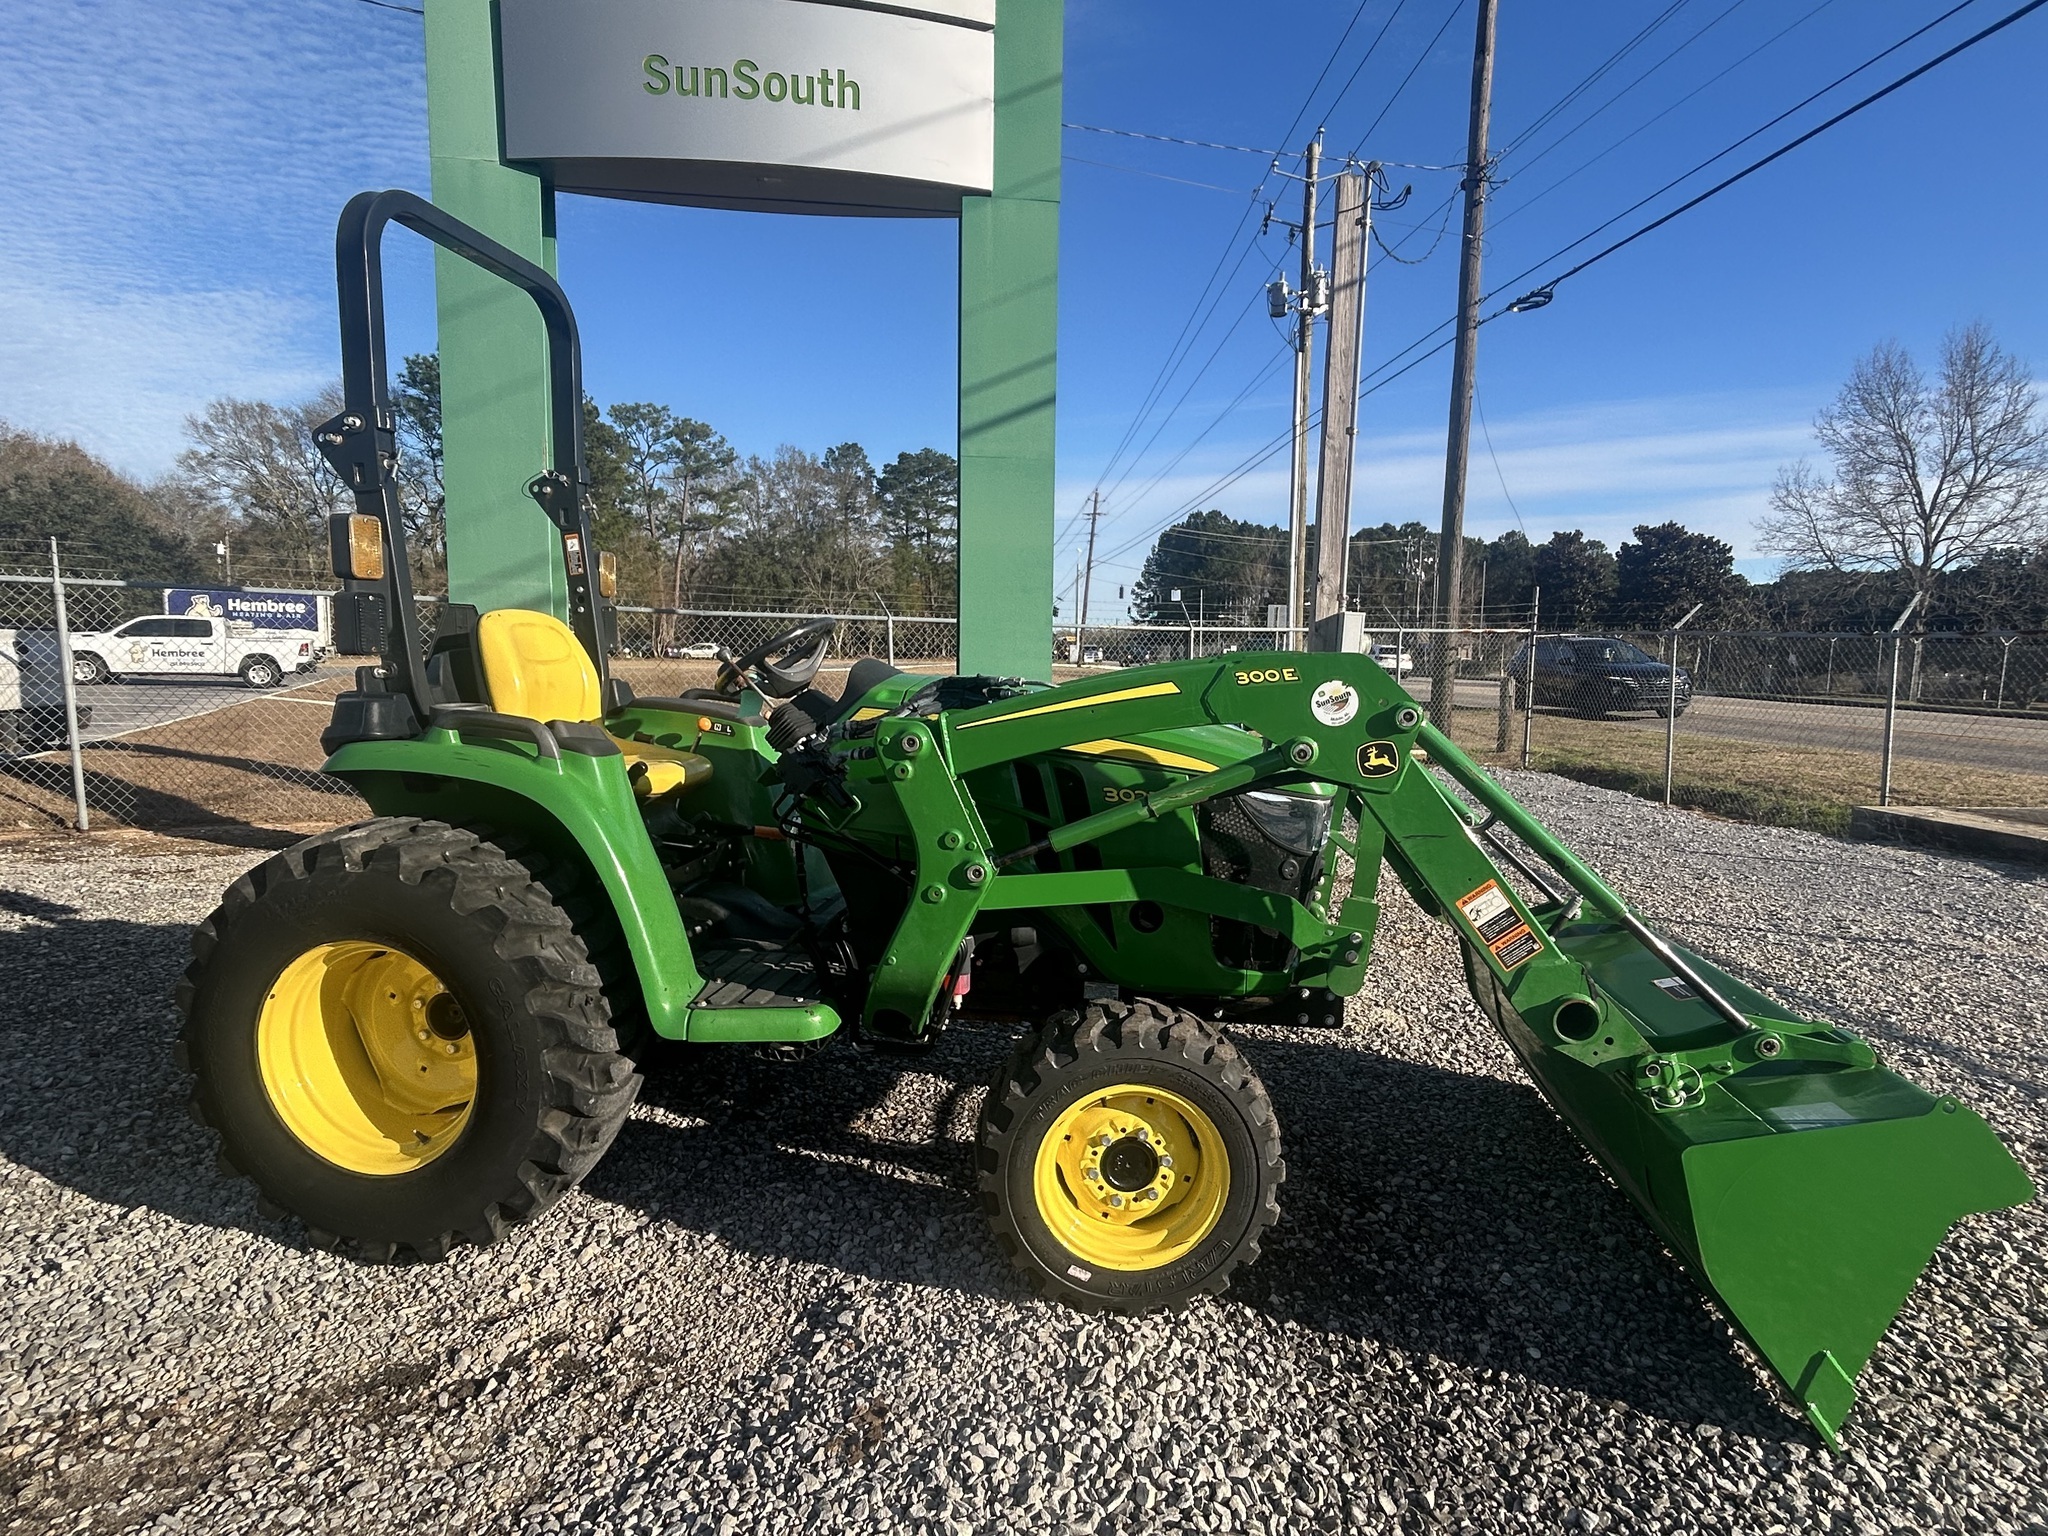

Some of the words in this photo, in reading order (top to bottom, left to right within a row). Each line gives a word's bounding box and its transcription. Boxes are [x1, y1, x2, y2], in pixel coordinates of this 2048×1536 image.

[641, 54, 861, 111] SunSouth
[227, 598, 306, 613] Hembree
[152, 649, 205, 658] Hembree
[1315, 691, 1352, 709] SunSouth
[727, 725, 732, 733] L
[1467, 883, 1492, 901] WARNING
[1501, 928, 1526, 946] WARNING
